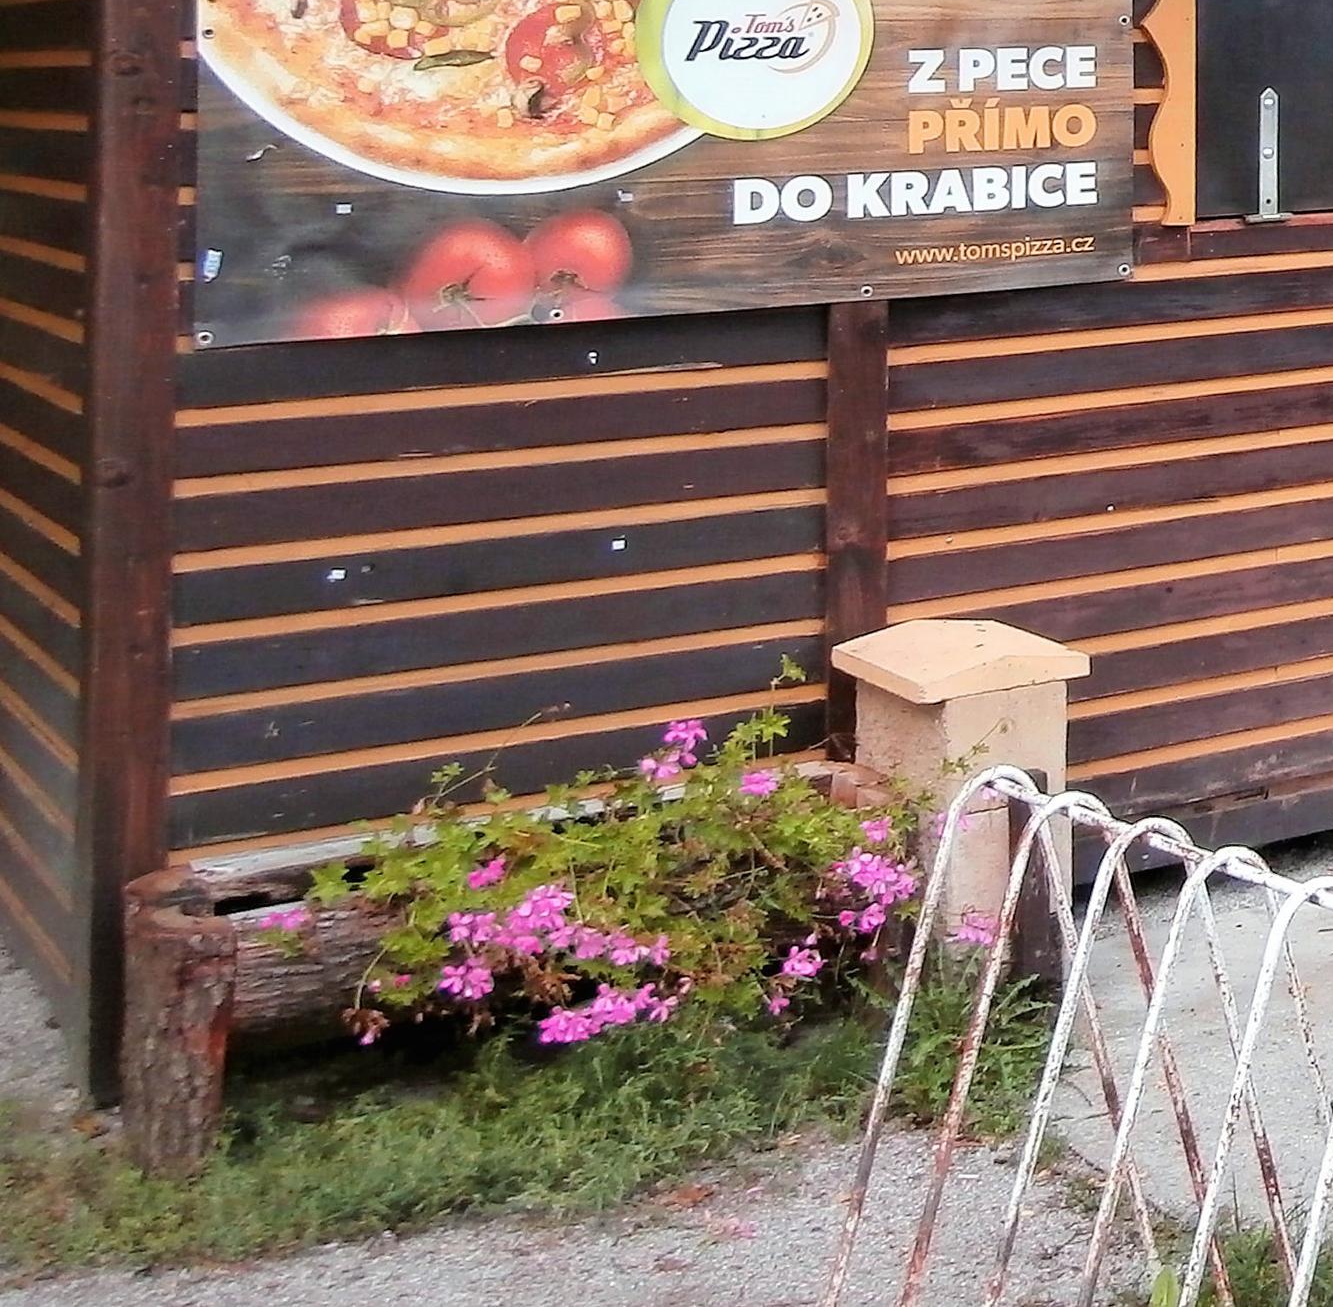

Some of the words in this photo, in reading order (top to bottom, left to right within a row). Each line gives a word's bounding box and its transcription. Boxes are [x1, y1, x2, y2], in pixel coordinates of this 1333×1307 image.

[684, 19, 810, 62] Pizza
[745, 13, 795, 34] Tom's
[908, 48, 947, 95] Z
[958, 46, 1097, 92] PECE
[908, 97, 1097, 155] PŘÍMO
[732, 175, 833, 226] DO
[847, 161, 1099, 219] KRABICE
[895, 234, 1096, 266] www.tomspizza.cz
